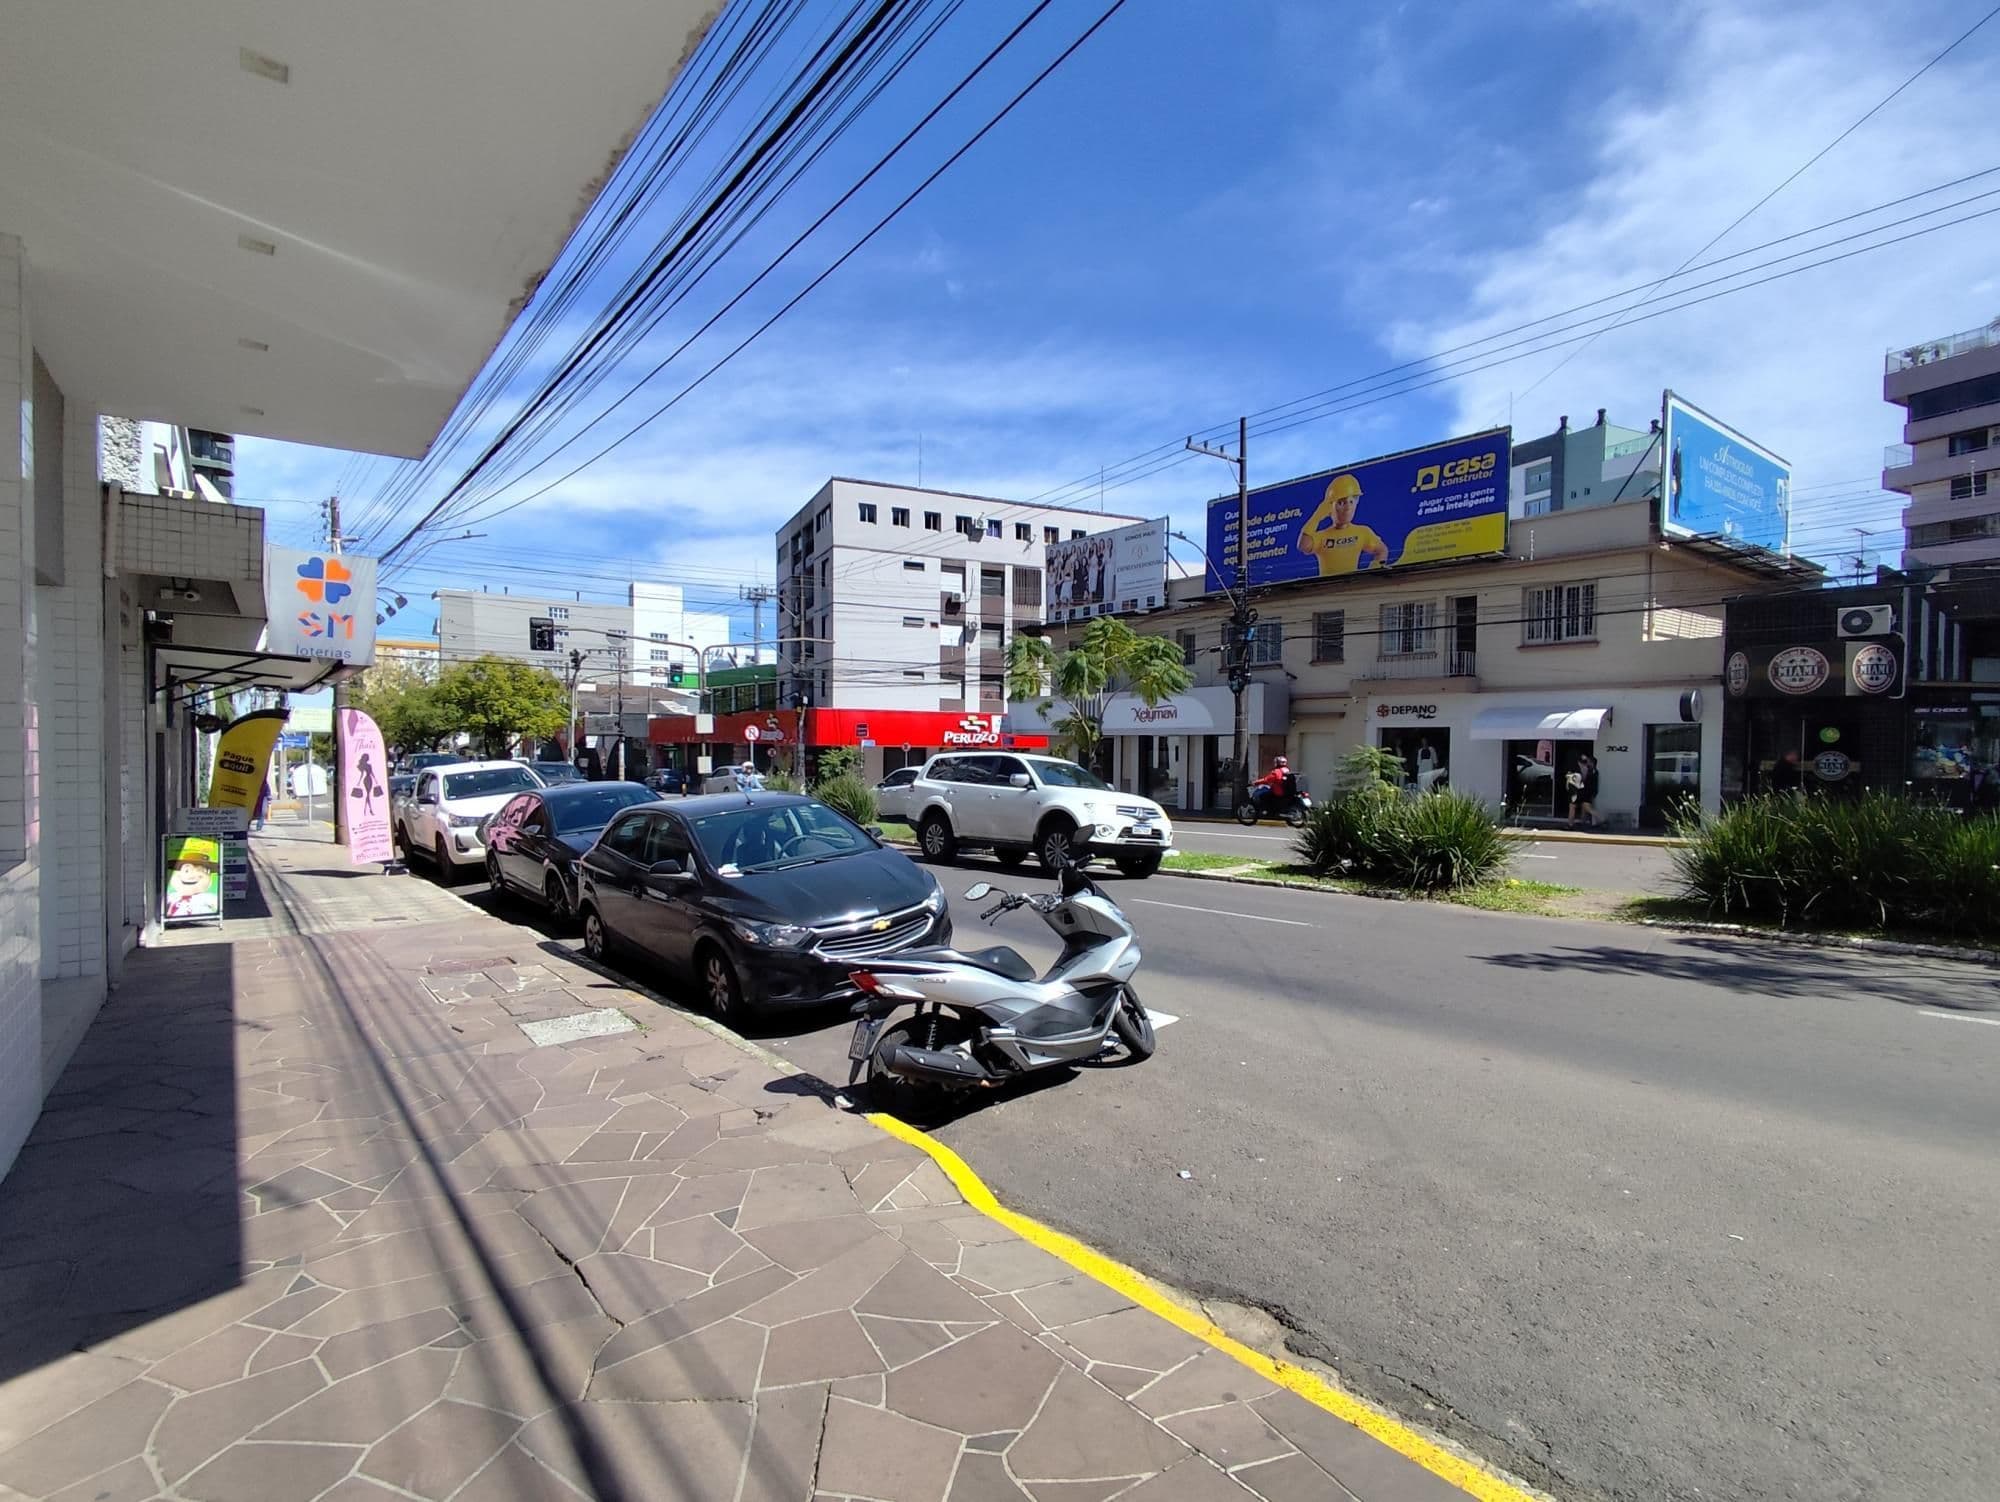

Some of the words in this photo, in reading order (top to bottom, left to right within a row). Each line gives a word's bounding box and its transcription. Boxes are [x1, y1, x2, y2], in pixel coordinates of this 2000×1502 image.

[1443, 452, 1496, 477] casa
[1442, 470, 1494, 486] construtor
[1419, 497, 1442, 507] alugar
[1444, 494, 1462, 503] com
[1470, 487, 1495, 499] gente
[1424, 504, 1444, 515] mais
[1446, 495, 1495, 510] inteligente
[1224, 511, 1239, 520] Que
[1263, 512, 1276, 522] de
[1277, 508, 1303, 520] obra,
[1264, 523, 1288, 534] quem
[1263, 535, 1276, 546] de
[297, 610, 353, 640] SM
[296, 643, 352, 659] loterias
[1777, 665, 1818, 676] MIAMI
[1860, 664, 1889, 675] MIAMI
[1392, 705, 1437, 714] DEPANO
[943, 731, 999, 744] PERUZZO
[223, 751, 255, 763] Pague
